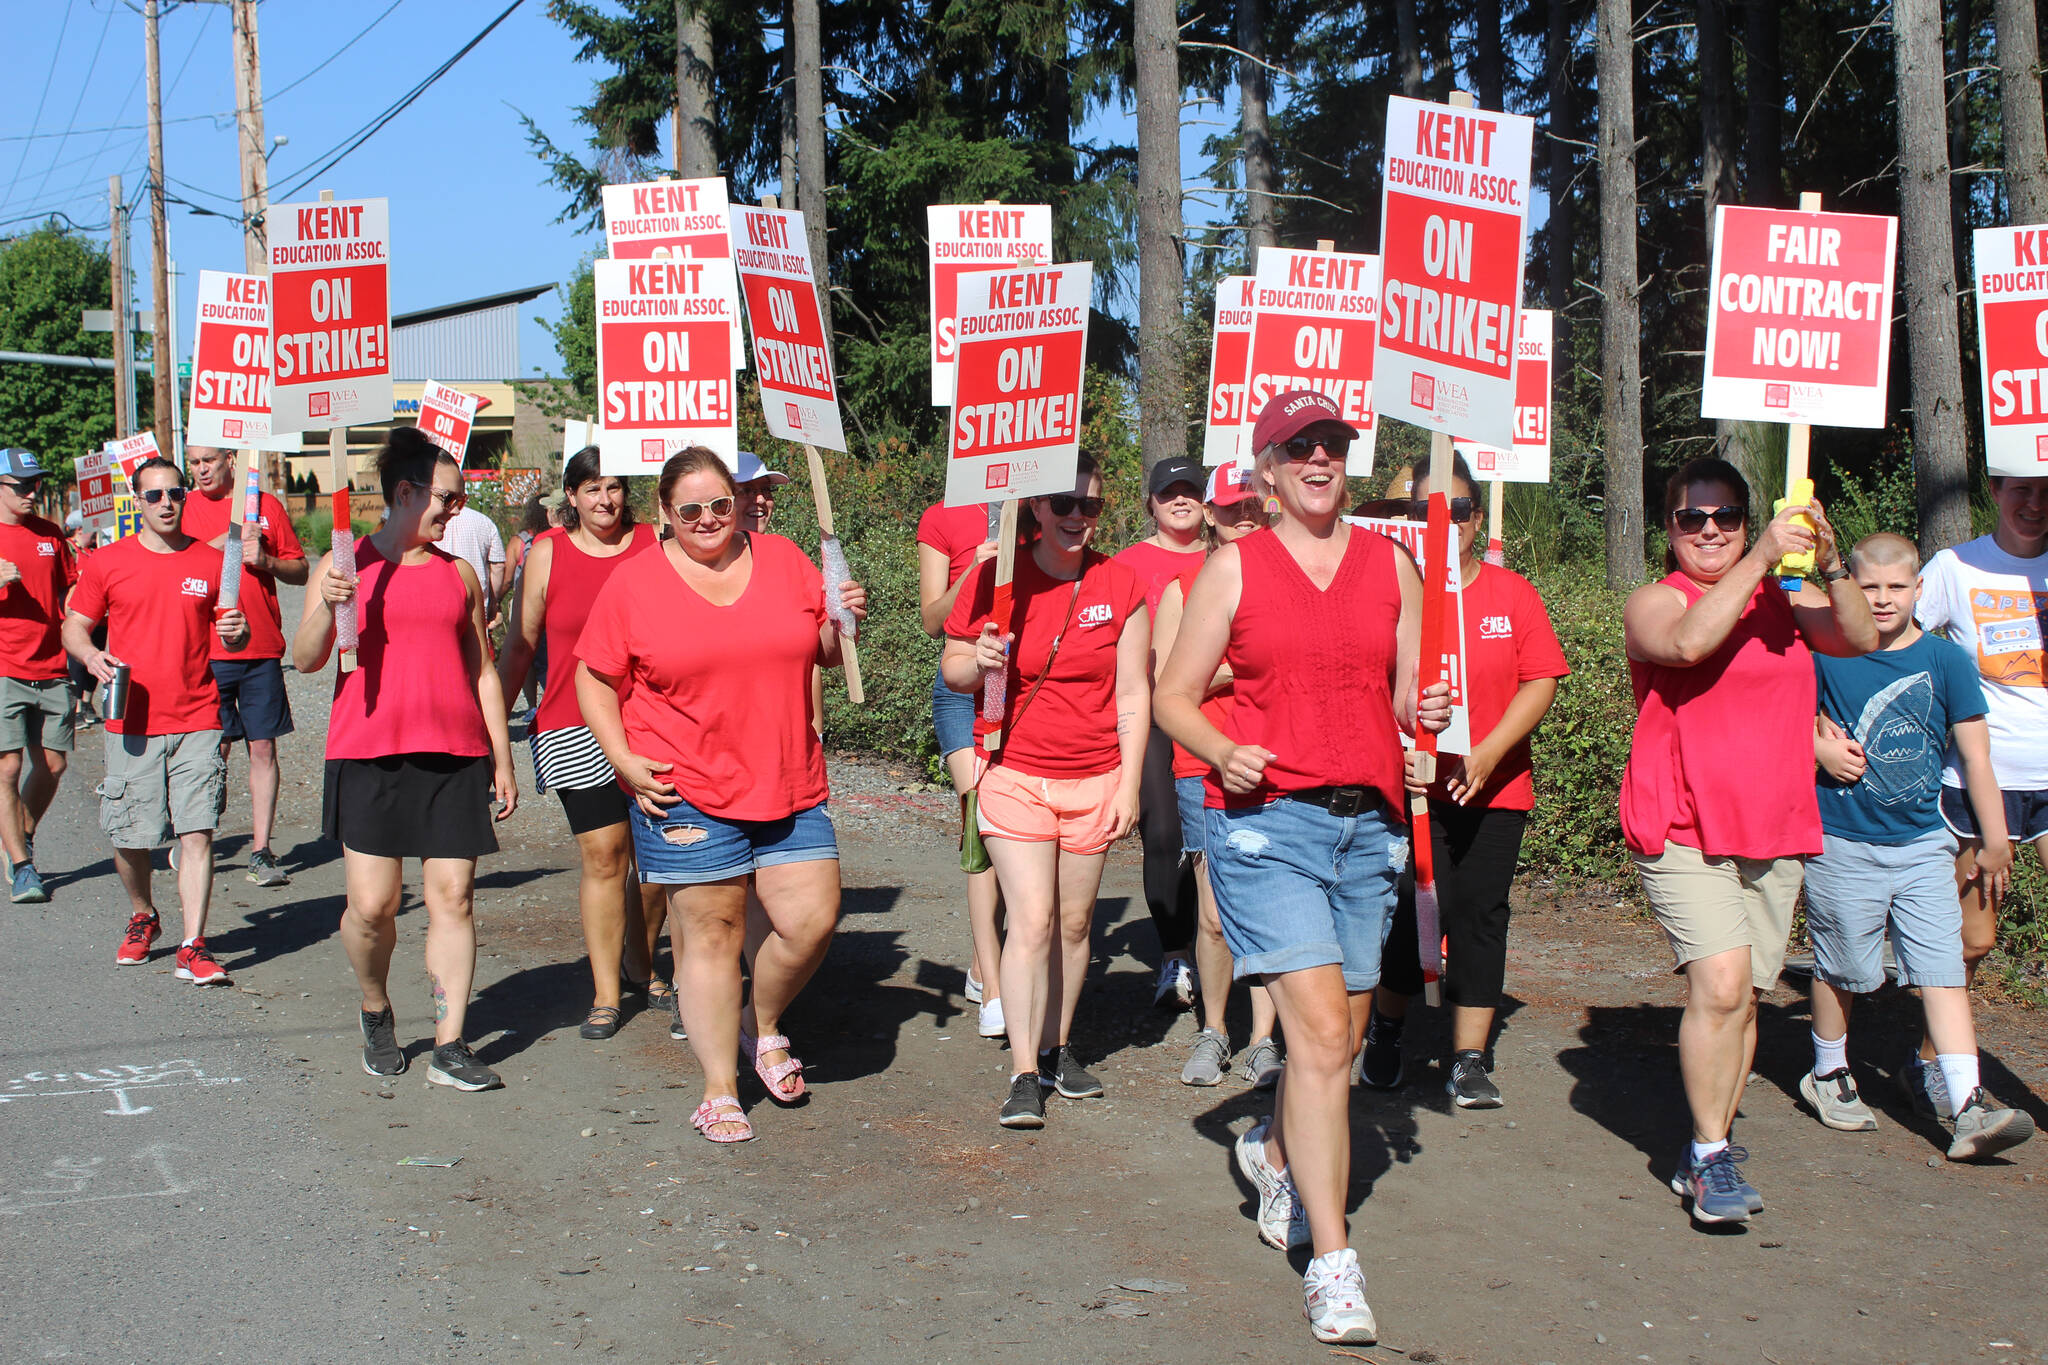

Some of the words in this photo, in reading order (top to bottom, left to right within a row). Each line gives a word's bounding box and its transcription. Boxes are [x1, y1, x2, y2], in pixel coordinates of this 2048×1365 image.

[1416, 110, 1497, 168] KENT
[1389, 157, 1464, 196] EDUCATION
[1468, 173, 1521, 206] ASSOC.
[633, 185, 700, 215] KENT
[298, 205, 364, 241] KENT
[611, 217, 680, 235] EDUCATION
[684, 214, 726, 231] ASSOC.
[745, 212, 789, 250] KENT
[958, 210, 1025, 239] KENT
[272, 244, 342, 265] EDUCATION
[346, 241, 386, 260] ASSOC.
[935, 242, 1002, 258] EDUCATION
[1007, 242, 1048, 258] ASSOC.
[1423, 214, 1474, 284] ON
[1767, 224, 1841, 267] FAIR
[2014, 230, 2048, 267] KE
[737, 248, 781, 271] EDUCATION
[782, 254, 810, 276] ASSOC.
[1288, 255, 1366, 291] KENT
[226, 277, 268, 305] KEN
[628, 264, 704, 295] KENT
[988, 271, 1063, 310] KENT
[1982, 271, 2048, 294] EDUCAT
[310, 277, 352, 323] ON
[603, 299, 678, 316] EDUCATION
[684, 298, 730, 315] ASSOC.
[767, 286, 800, 334] ON
[1259, 289, 1336, 312] EDUCATION
[1339, 296, 1378, 315] ASSO
[1719, 272, 1883, 321] CONTRACT
[202, 304, 266, 321] EDUCATION
[960, 311, 1035, 336] EDUCATION
[1039, 306, 1083, 328] ASSOC.
[1218, 310, 1252, 326] EDUCA
[1383, 278, 1511, 367] STRIKE!
[233, 333, 270, 368] ON
[276, 324, 386, 378] STRIKE!
[643, 331, 690, 373] ON
[1294, 325, 1343, 370] ON
[1518, 341, 1546, 356] SSOC.
[1752, 327, 1841, 371] NOW!
[757, 336, 831, 392] STRIKE!
[997, 345, 1044, 393] ON
[198, 369, 272, 408] STRIK
[331, 390, 358, 401] WEA
[436, 386, 466, 407] KENT
[606, 379, 729, 423] STRIKE!
[1437, 380, 1469, 401] WEA
[1792, 385, 1824, 399] WEA
[800, 407, 818, 420] WEA
[1283, 395, 1316, 416] SANTA
[244, 420, 268, 431] WEA
[434, 414, 455, 436] ON
[957, 393, 1075, 450] STRIKE!
[122, 436, 146, 451] KENT
[83, 454, 103, 469] KENT
[1011, 459, 1039, 472] WEA
[89, 478, 102, 495] ON
[82, 493, 113, 515] STRIKE!
[190, 578, 208, 594] KEA
[1089, 604, 1113, 621] KEA
[1490, 615, 1512, 634] KEA
